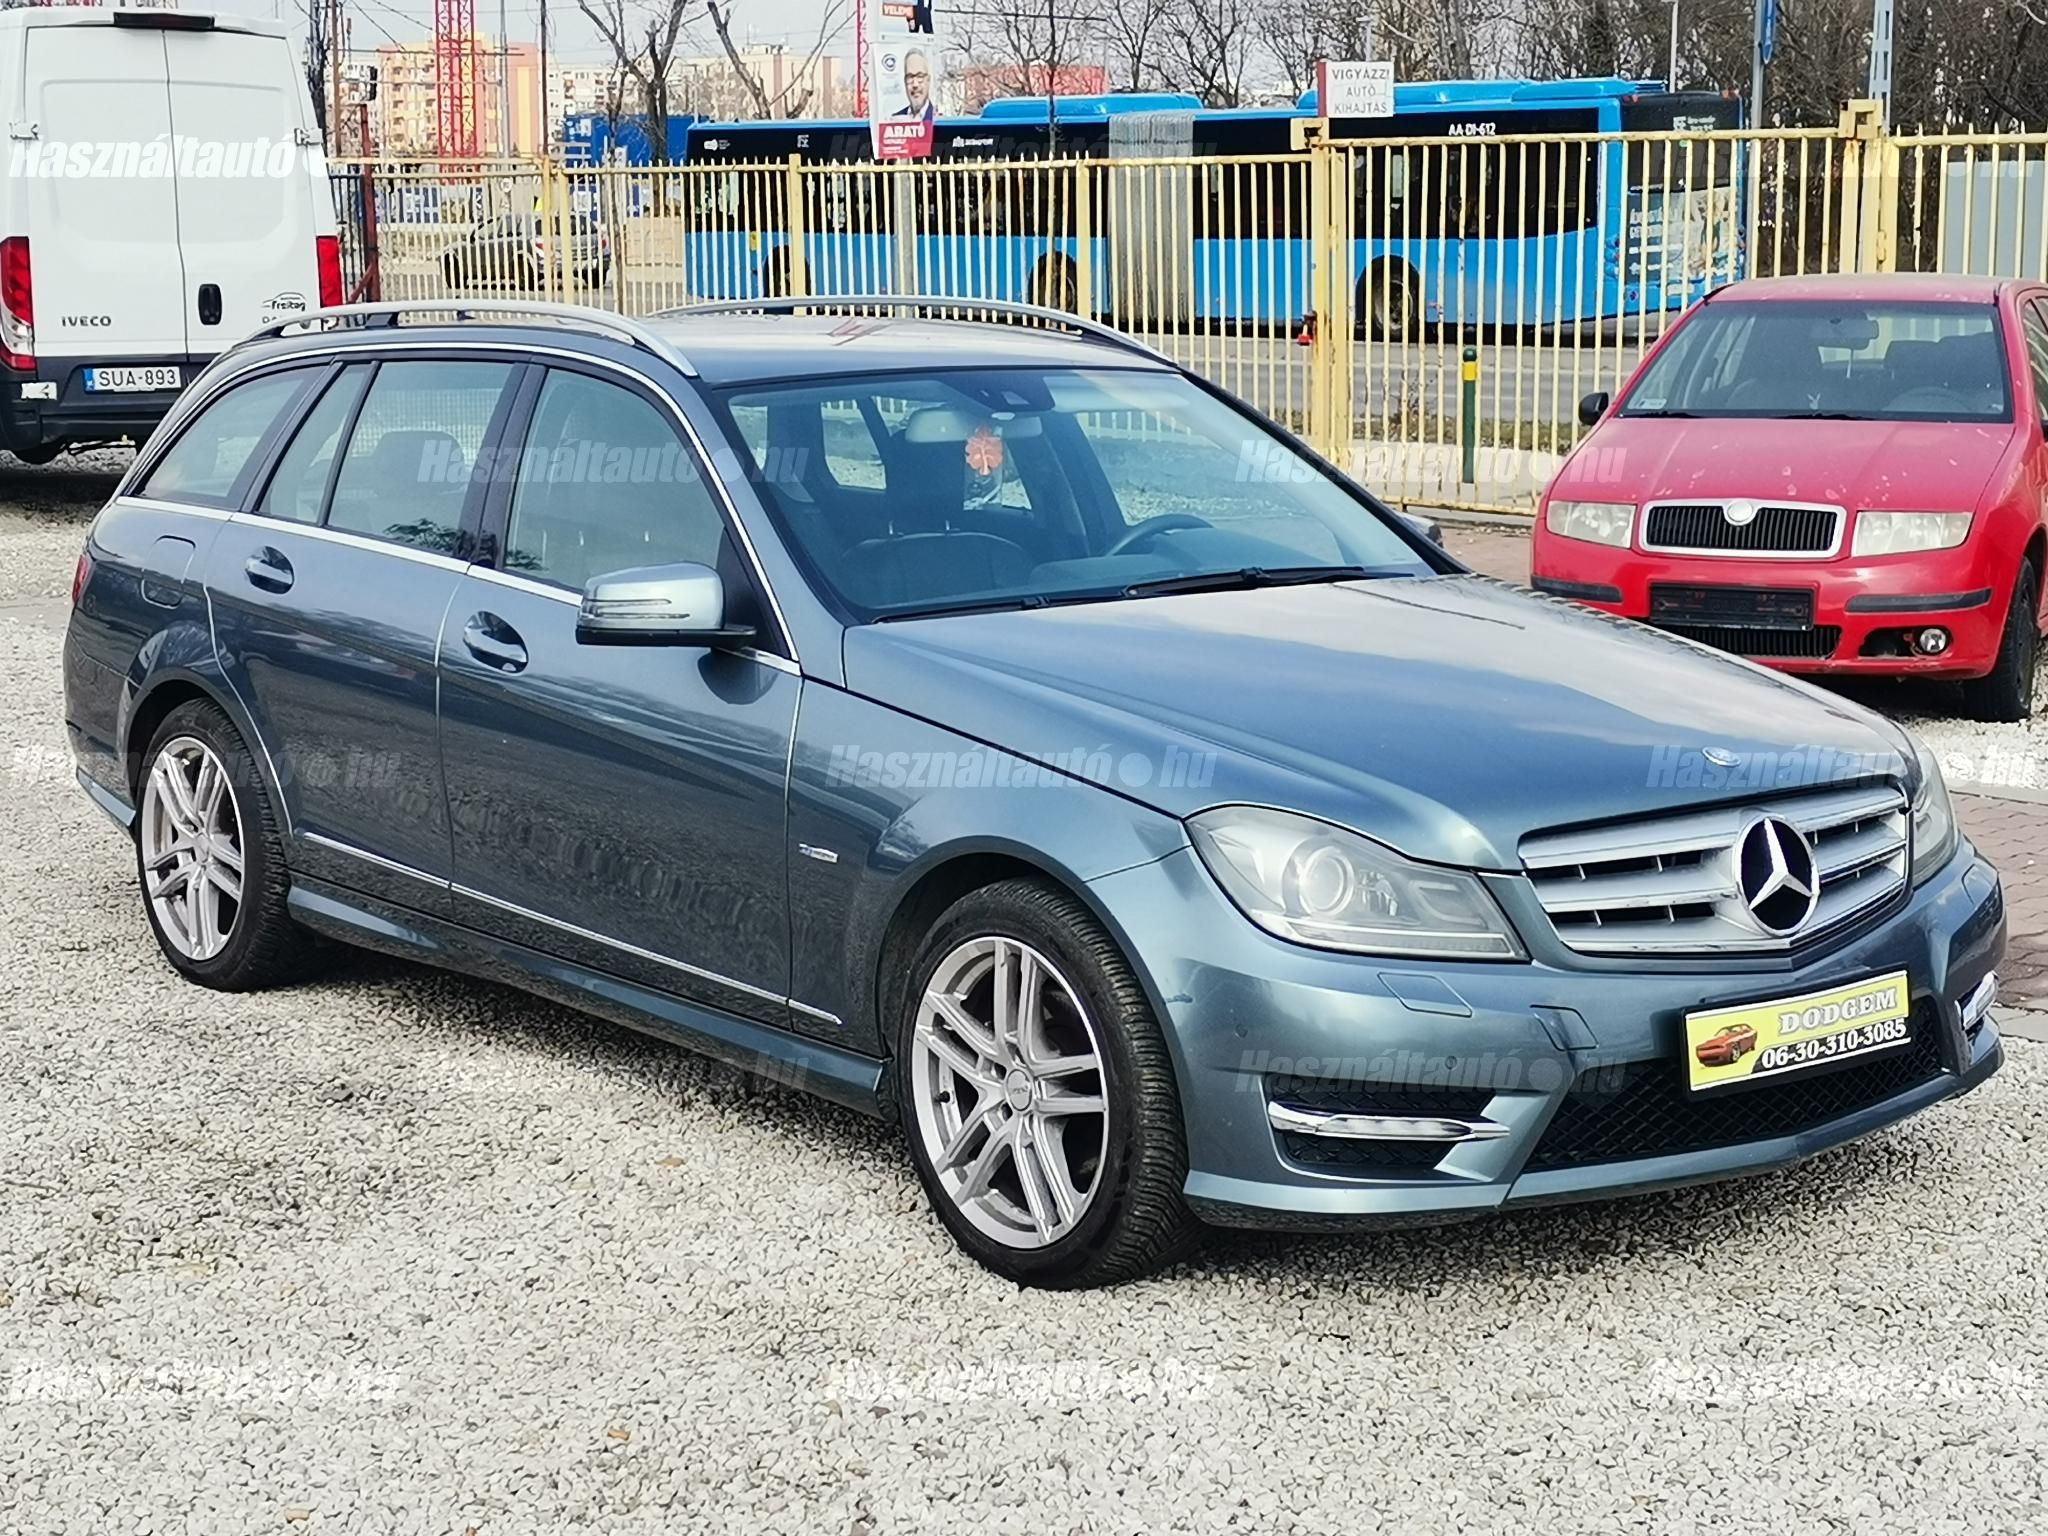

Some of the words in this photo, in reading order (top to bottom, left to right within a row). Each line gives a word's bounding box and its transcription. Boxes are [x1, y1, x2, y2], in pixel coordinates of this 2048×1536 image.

[61, 315, 112, 327] IVECO
[98, 368, 177, 387] SUA-893
[1777, 987, 1898, 1036] DODGEM
[1761, 1017, 1908, 1070] 06-30-310-3085
